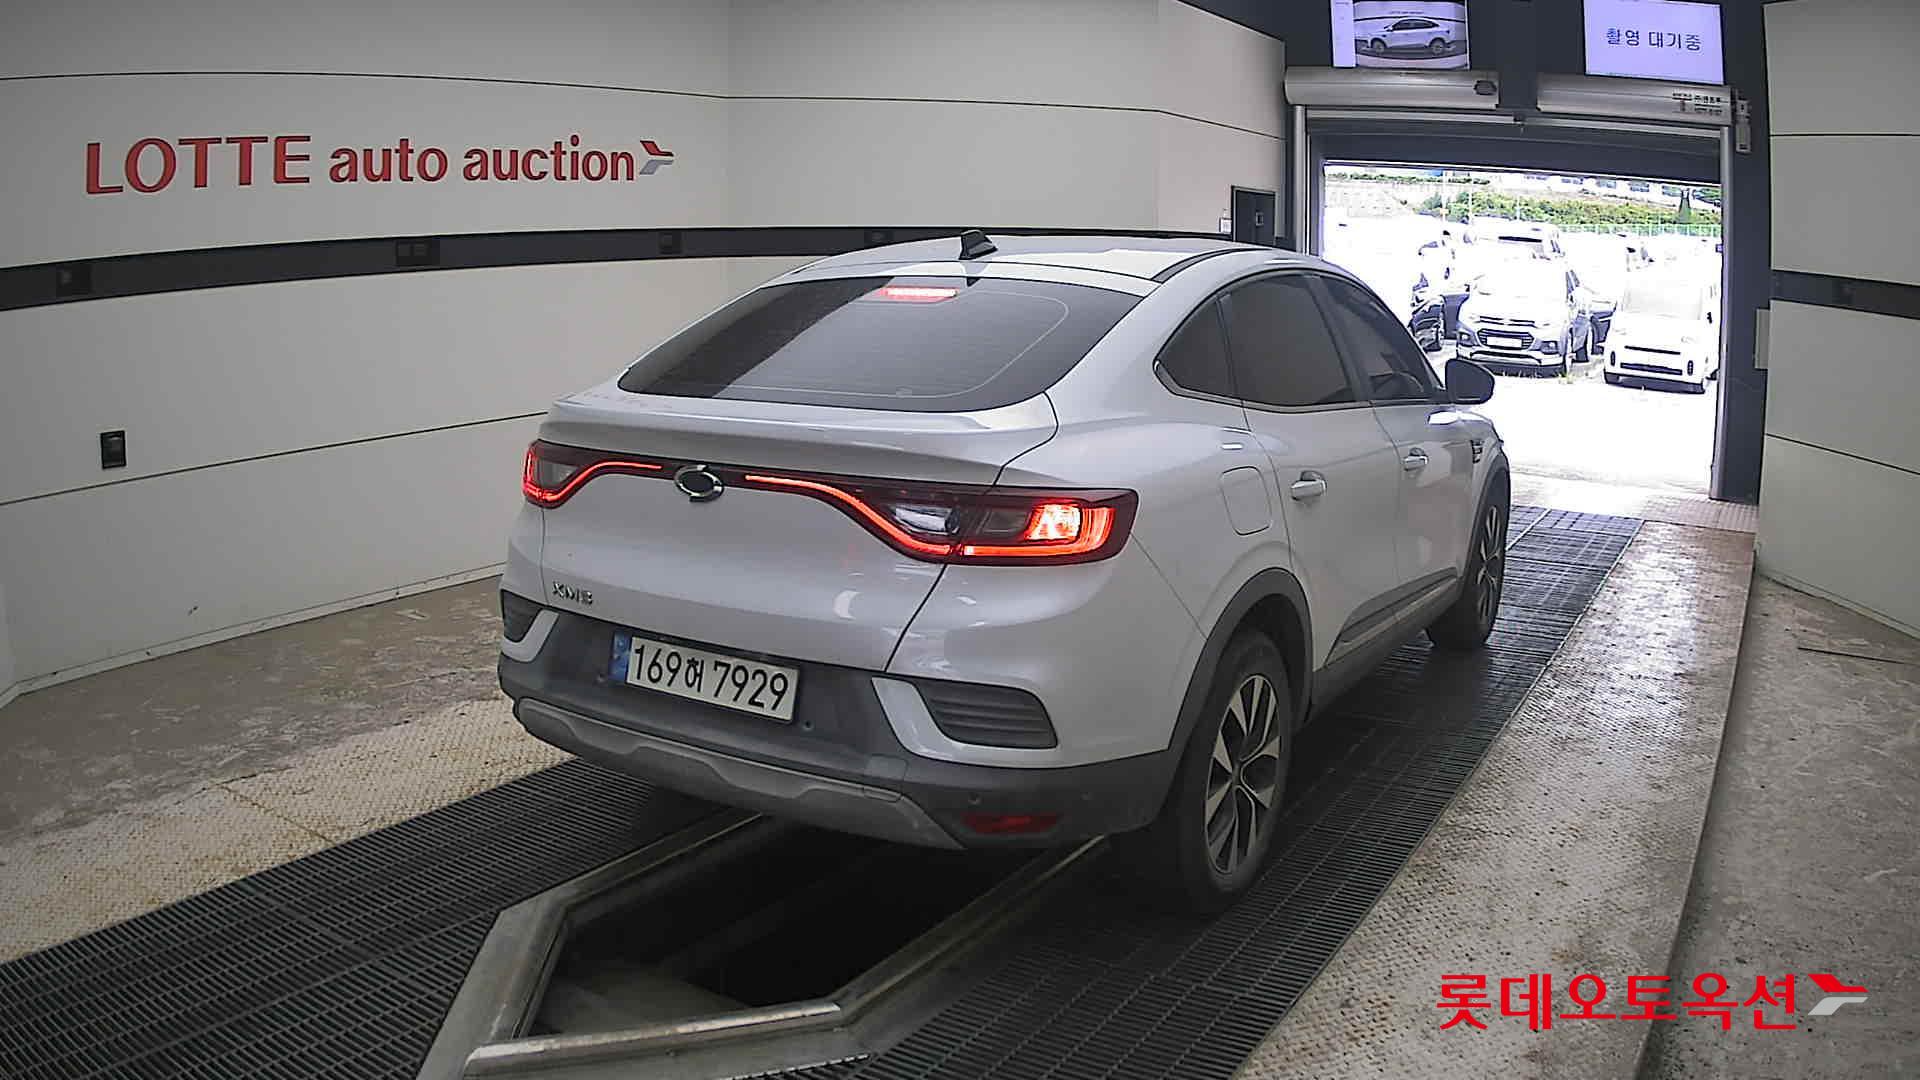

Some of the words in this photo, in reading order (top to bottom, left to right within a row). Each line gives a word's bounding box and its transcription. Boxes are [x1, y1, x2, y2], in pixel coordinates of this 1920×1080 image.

[1648, 31, 1702, 51] 대기중
[85, 134, 311, 195] LOTTE
[329, 137, 449, 183] auto
[462, 134, 634, 182] auction
[634, 644, 705, 693] 169허
[713, 660, 789, 711] 7929
